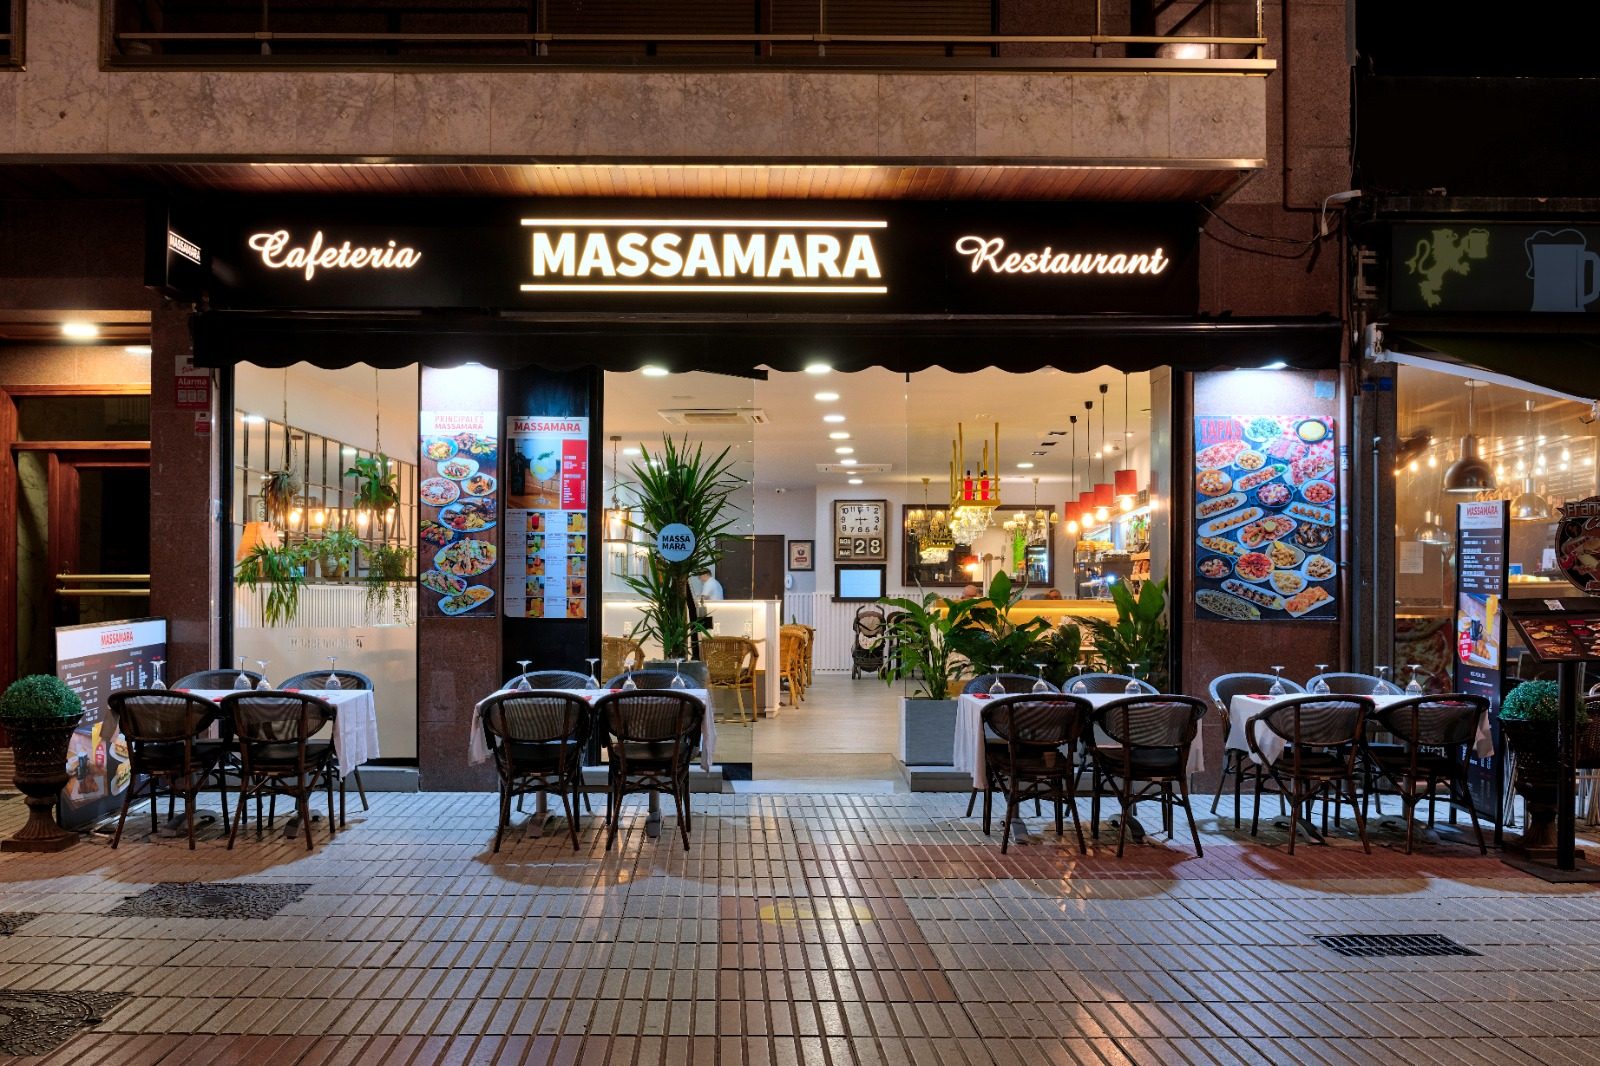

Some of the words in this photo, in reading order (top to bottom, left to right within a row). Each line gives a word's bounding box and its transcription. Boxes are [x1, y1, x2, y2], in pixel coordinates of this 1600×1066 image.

[249, 230, 422, 281] Cafeteria
[533, 232, 881, 278] MASSAMARA
[955, 235, 1169, 275] Restaurant
[435, 415, 484, 423] PRINCIPALES
[514, 421, 581, 432] MASSAMARA
[1201, 419, 1242, 438] TAPAS
[662, 535, 691, 543] MASSA
[101, 631, 134, 646] MASSAMARA
